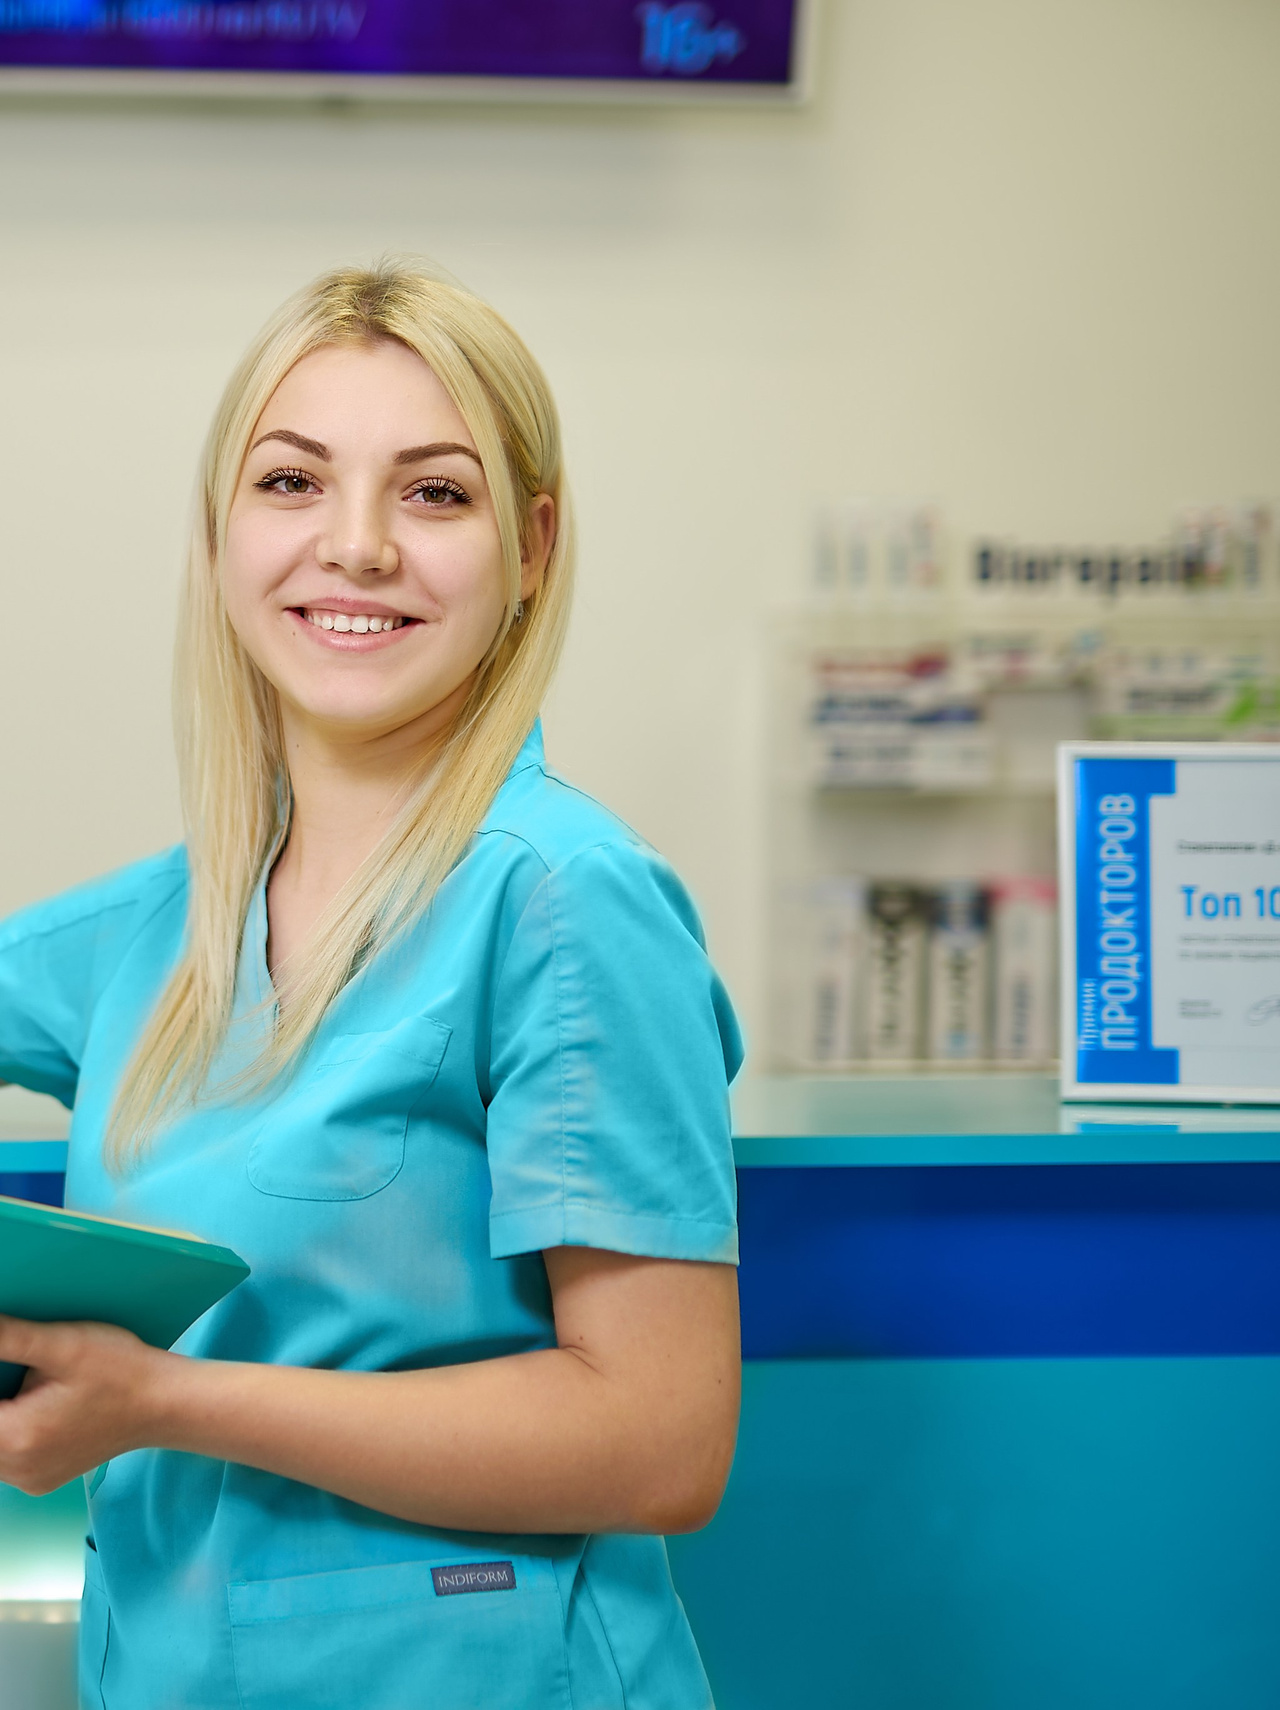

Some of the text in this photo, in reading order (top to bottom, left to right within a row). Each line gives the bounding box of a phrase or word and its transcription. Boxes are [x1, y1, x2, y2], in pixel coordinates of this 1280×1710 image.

[1180, 885, 1241, 919] Топ
[1099, 793, 1142, 1051] ПРОДОКТОРОВ
[438, 1570, 509, 1588] INDIFORM
